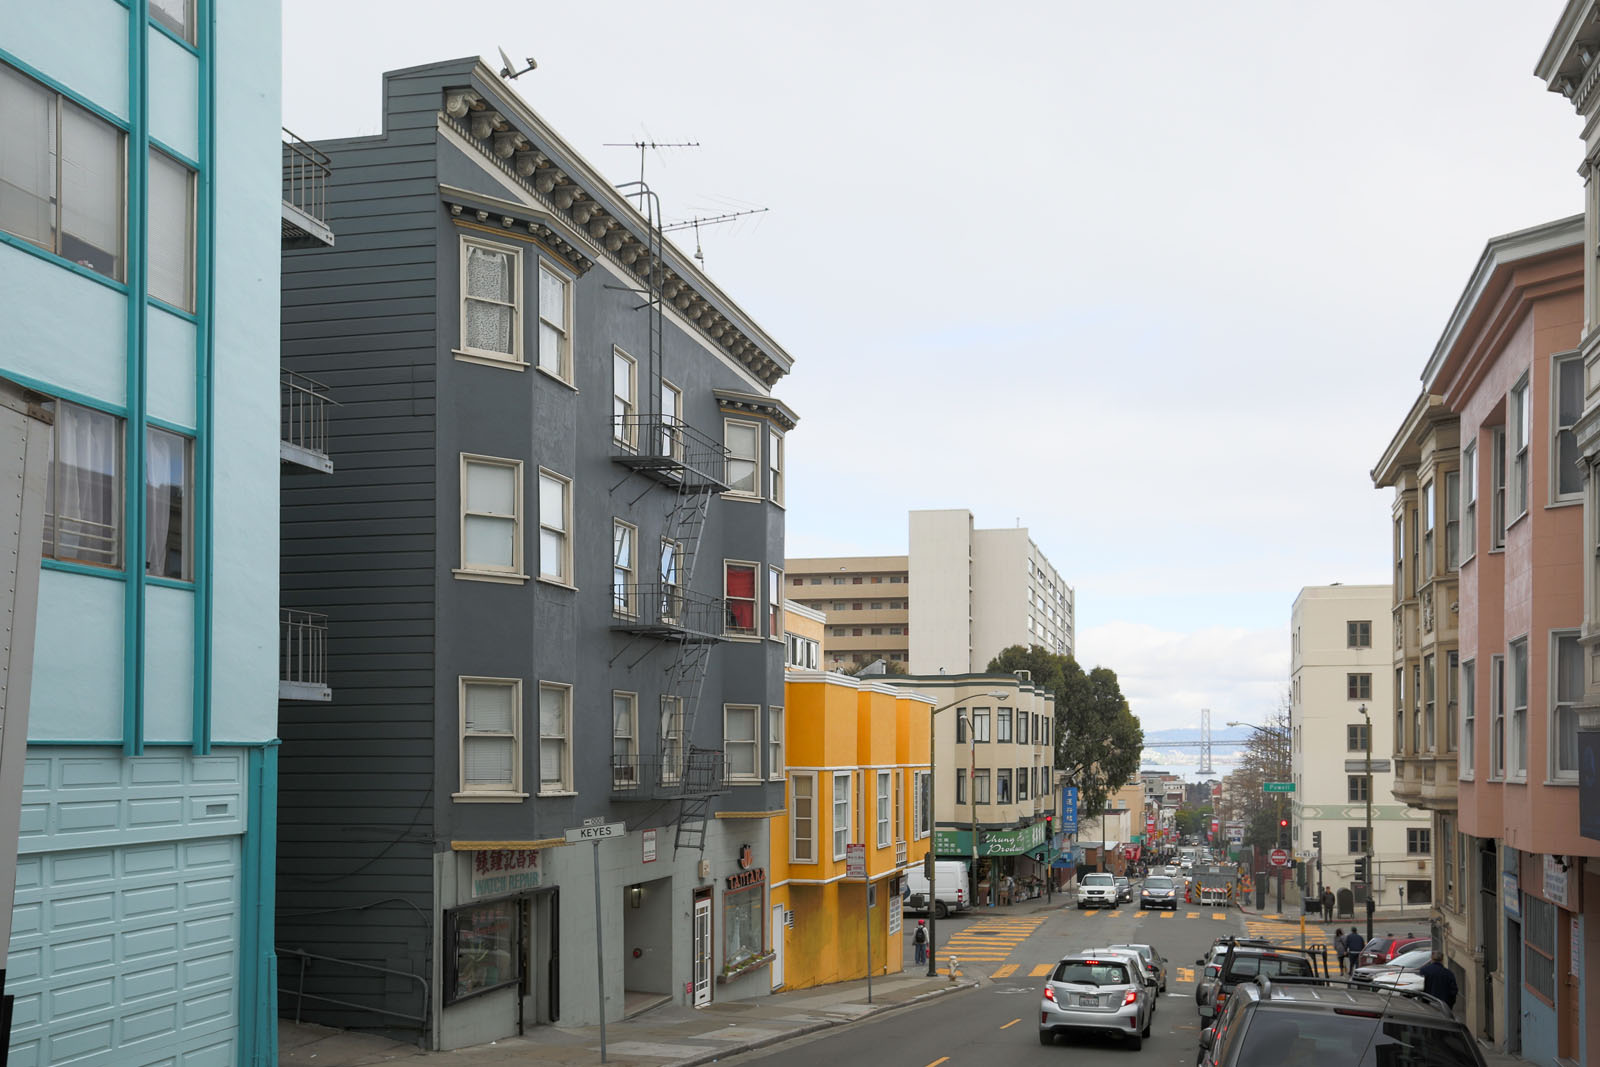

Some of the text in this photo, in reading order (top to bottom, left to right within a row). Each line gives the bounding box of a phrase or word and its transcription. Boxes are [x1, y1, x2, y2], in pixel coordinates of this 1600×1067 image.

[580, 826, 612, 838] KEYES
[474, 871, 540, 897] WATCH REPAIR
